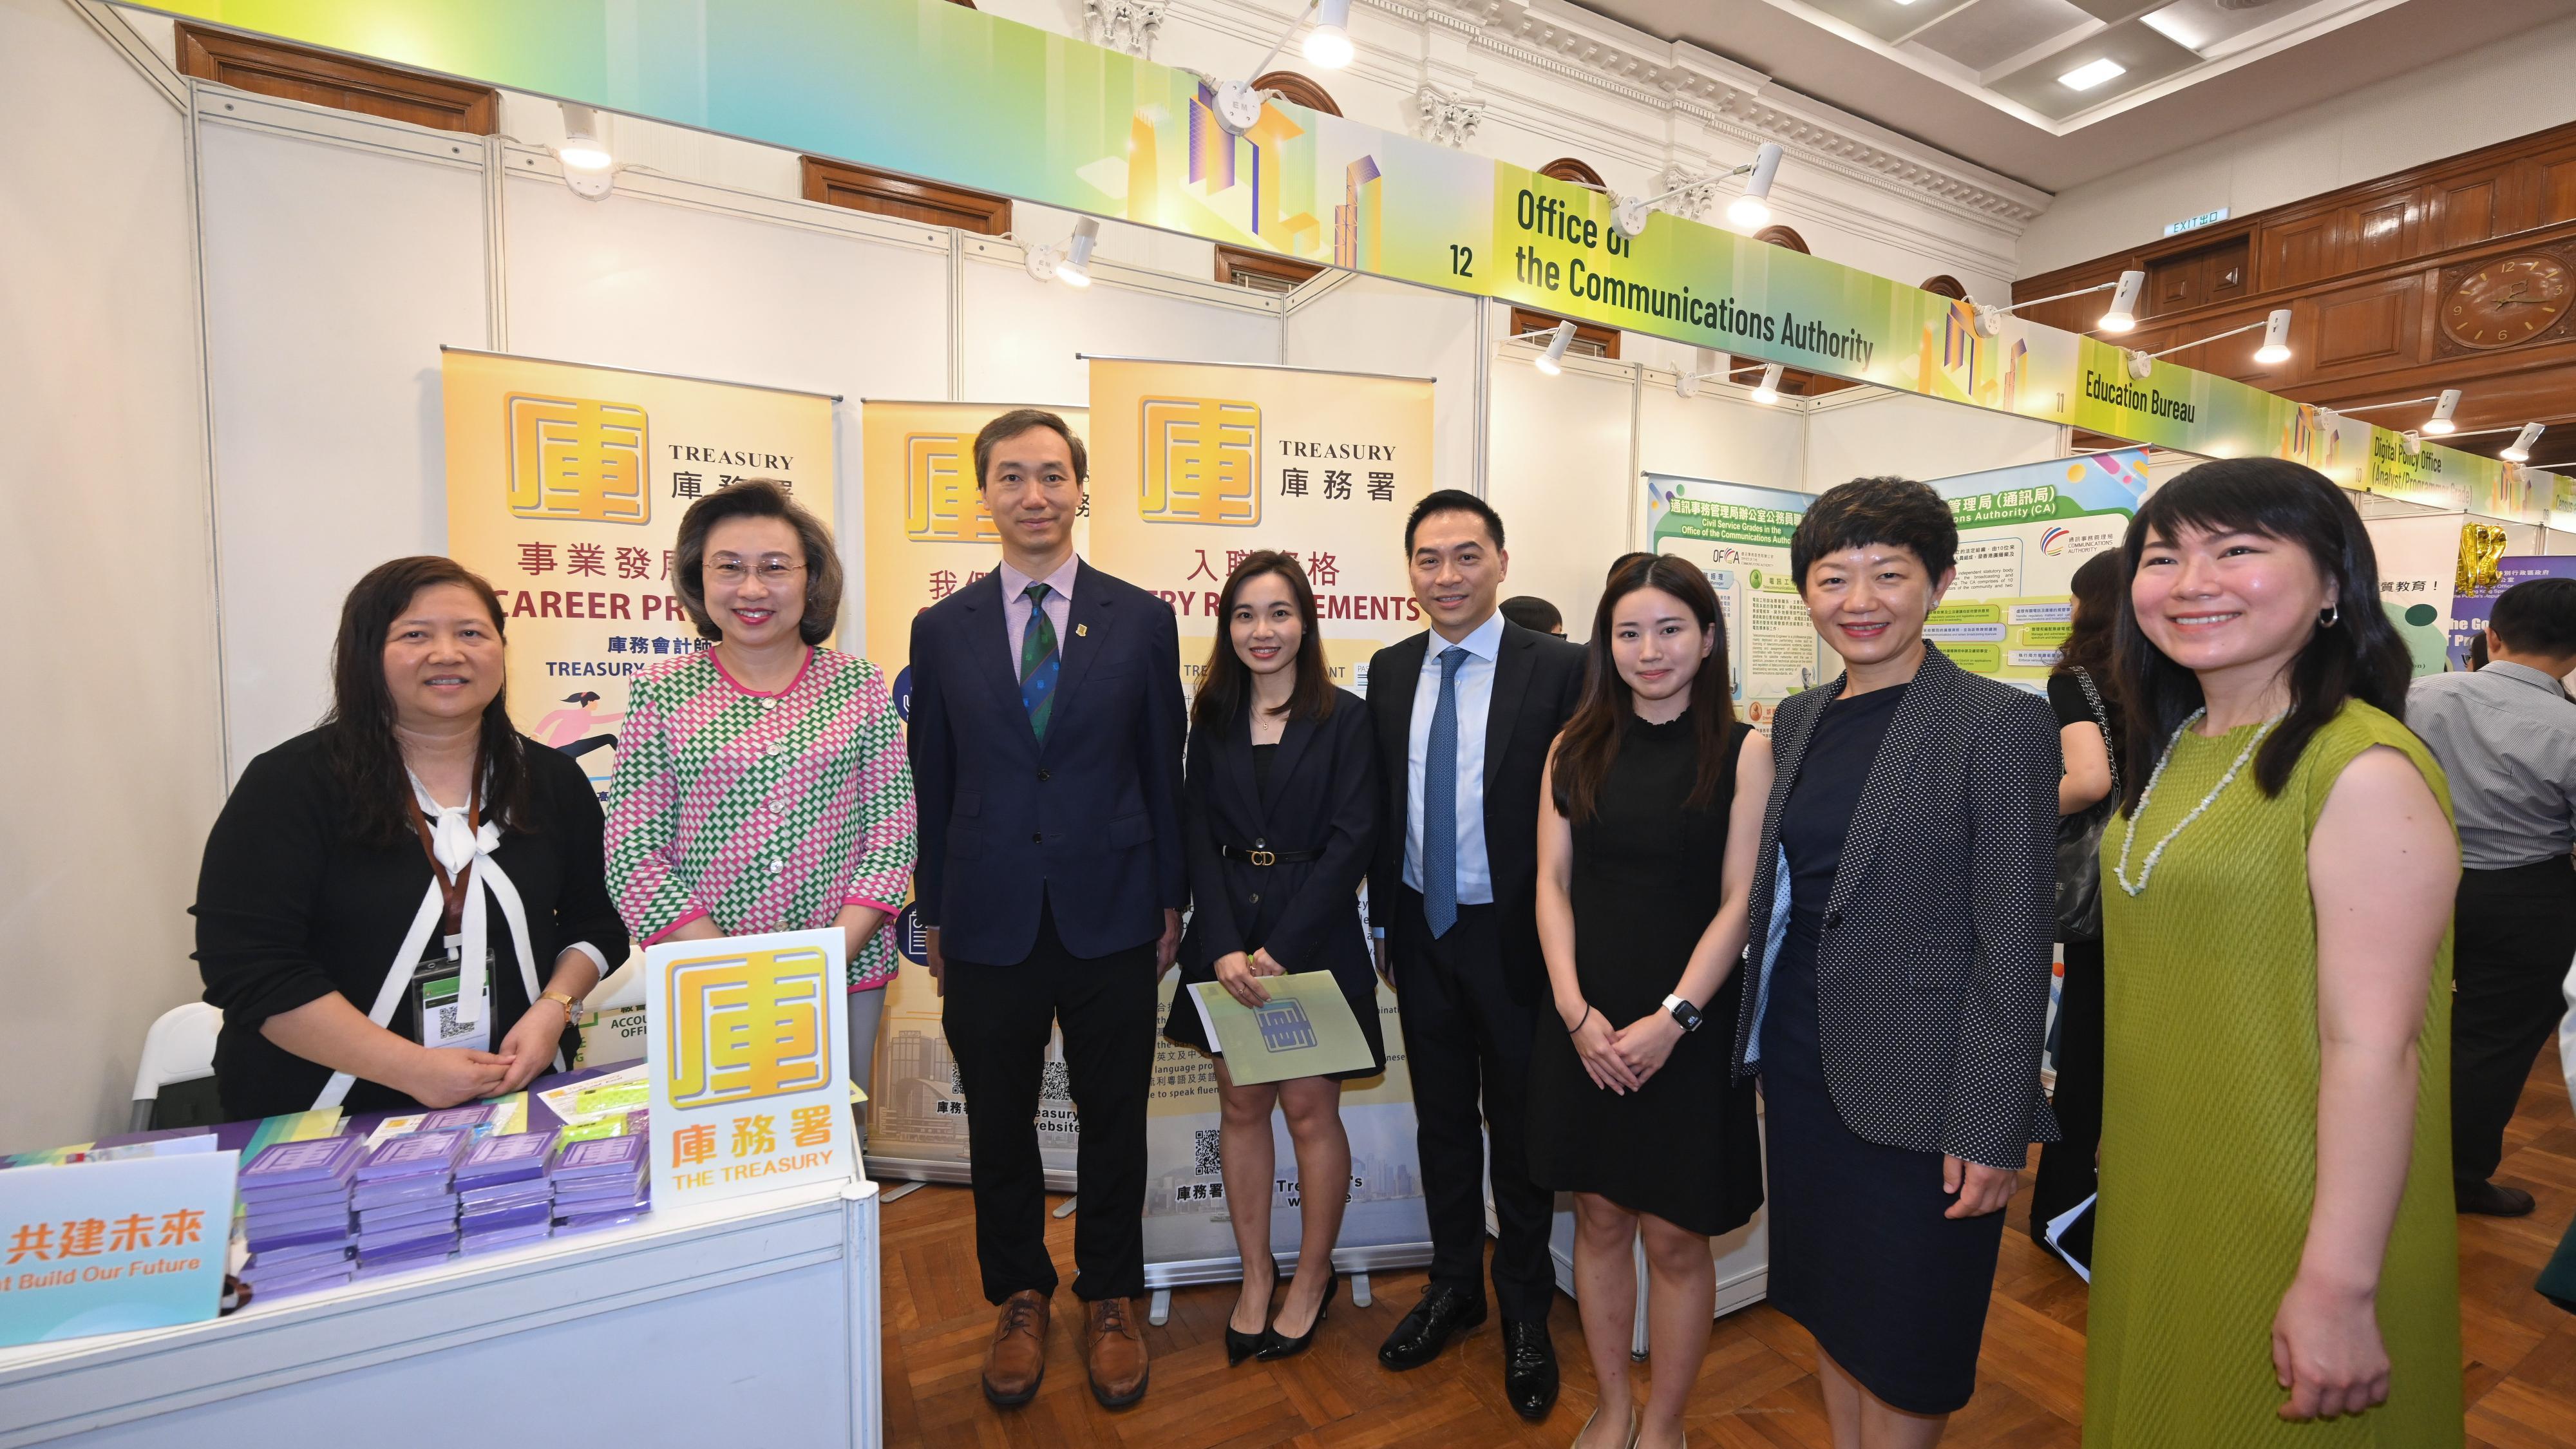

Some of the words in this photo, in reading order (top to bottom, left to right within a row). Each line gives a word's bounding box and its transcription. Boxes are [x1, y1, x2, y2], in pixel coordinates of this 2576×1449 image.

[1517, 189, 1597, 249] Office
[2174, 218, 2197, 233] EXIT
[2200, 212, 2217, 225] 出口
[1450, 245, 1473, 278] 12
[2501, 261, 2515, 273] 12
[2554, 285, 2563, 296] 3
[1516, 246, 1560, 291] the
[1569, 258, 1774, 342] Communications
[1781, 312, 1873, 372] Authority
[2453, 306, 2462, 316] 9
[2498, 330, 2508, 340] 6
[2056, 392, 2065, 413] 11
[2086, 370, 2147, 412] Education
[2151, 389, 2195, 424] Bureau
[668, 444, 794, 470] TREASURY
[1280, 440, 1397, 462] TREASURY
[2374, 436, 2396, 464] Digital
[2399, 444, 2420, 472] Policy
[2421, 450, 2441, 473] Office
[1281, 468, 1396, 502] 庫務署
[2355, 468, 2362, 483] 10
[1975, 507, 2029, 522] Authority
[2031, 503, 2056, 516] (CA)
[2556, 495, 2573, 513] Census
[1682, 526, 1701, 536] Office
[1702, 527, 1709, 536] of
[1710, 529, 1719, 538] the
[1721, 529, 1771, 542] Communications
[1772, 534, 1792, 545] Autho
[1702, 518, 1716, 527] Civil
[1718, 520, 1740, 530] Service
[1742, 522, 1763, 533] Grades
[1764, 524, 1770, 533] in
[1772, 525, 1781, 535] the
[2068, 540, 2113, 548] COMMUNICATIONS
[645, 595, 685, 621] PR
[608, 636, 712, 655] 庫務會計師
[621, 1027, 647, 1038] OFFI
[1155, 1063, 1196, 1075] language
[1198, 1063, 1213, 1074] pro
[1158, 1088, 1166, 1098] to
[1170, 1086, 1195, 1099] speak
[1198, 1086, 1219, 1095] fluen
[1036, 1108, 1078, 1122] easury
[672, 1104, 833, 1168] 庫務署
[672, 1170, 715, 1191] THE
[721, 1150, 834, 1182] TREASURY
[1177, 1183, 1224, 1201] 庫務署
[5, 1208, 206, 1265] 共建未來
[19, 1268, 77, 1290] Build
[82, 1265, 123, 1282] Our
[129, 1257, 201, 1277] Future
